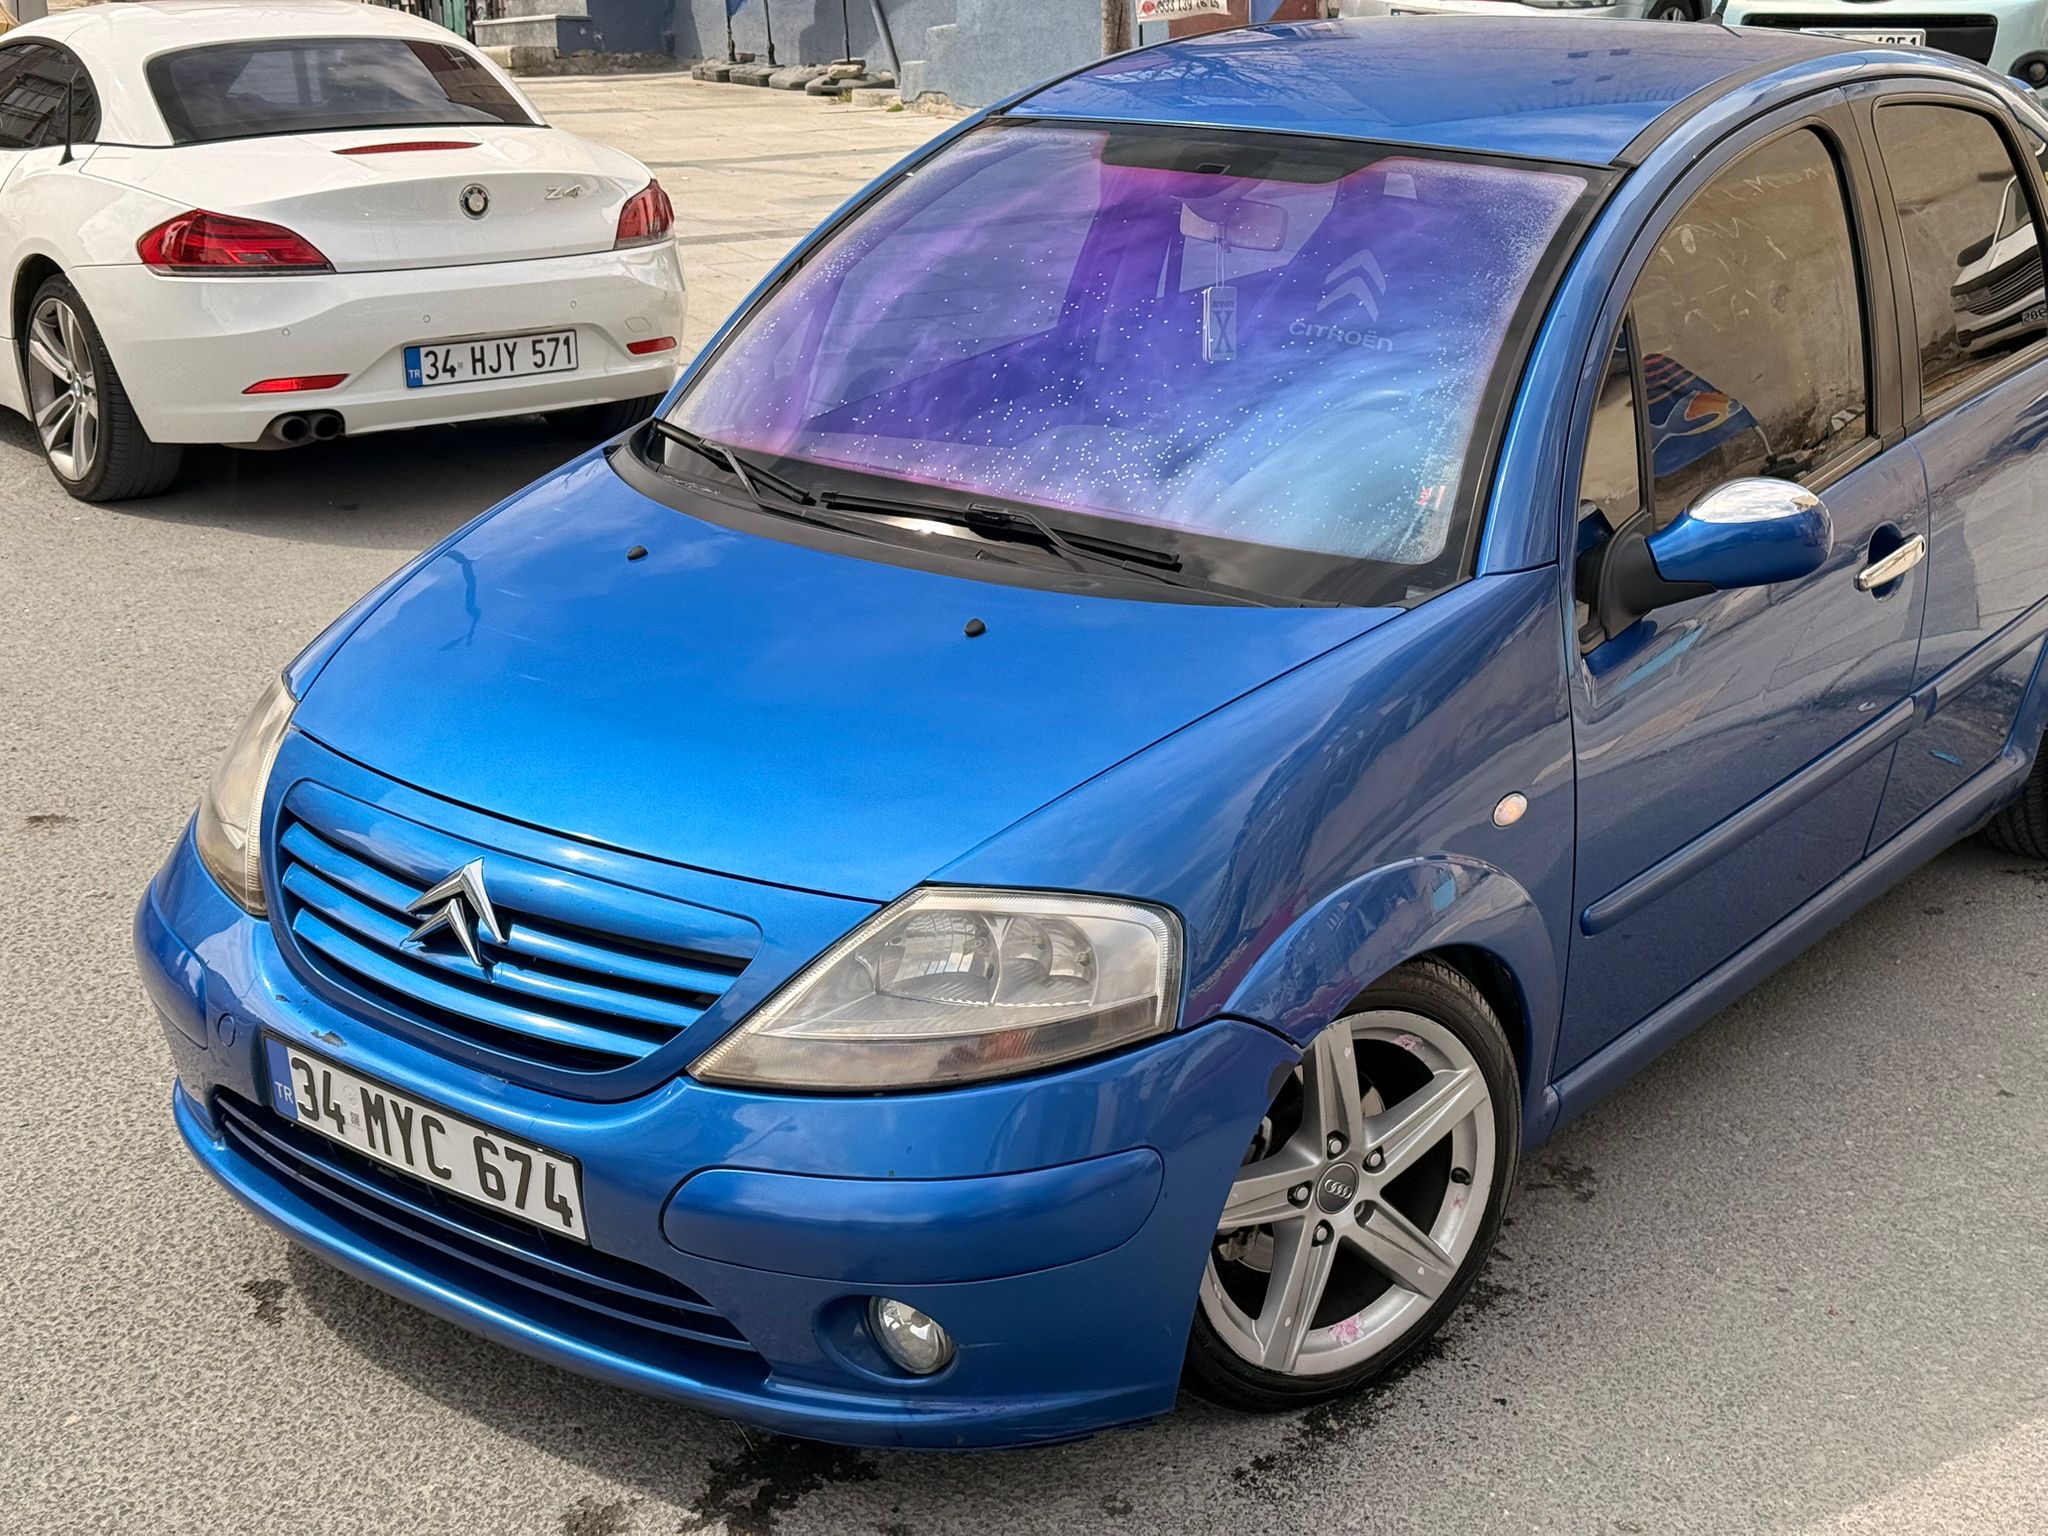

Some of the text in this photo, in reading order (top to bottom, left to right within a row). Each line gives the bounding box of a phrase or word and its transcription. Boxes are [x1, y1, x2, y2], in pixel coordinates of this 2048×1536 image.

[544, 184, 581, 200] Z4
[424, 335, 572, 381] 34 HJY 571
[408, 369, 421, 379] TR
[274, 1080, 294, 1105] TR
[290, 1056, 573, 1229] 34 MYC 674
